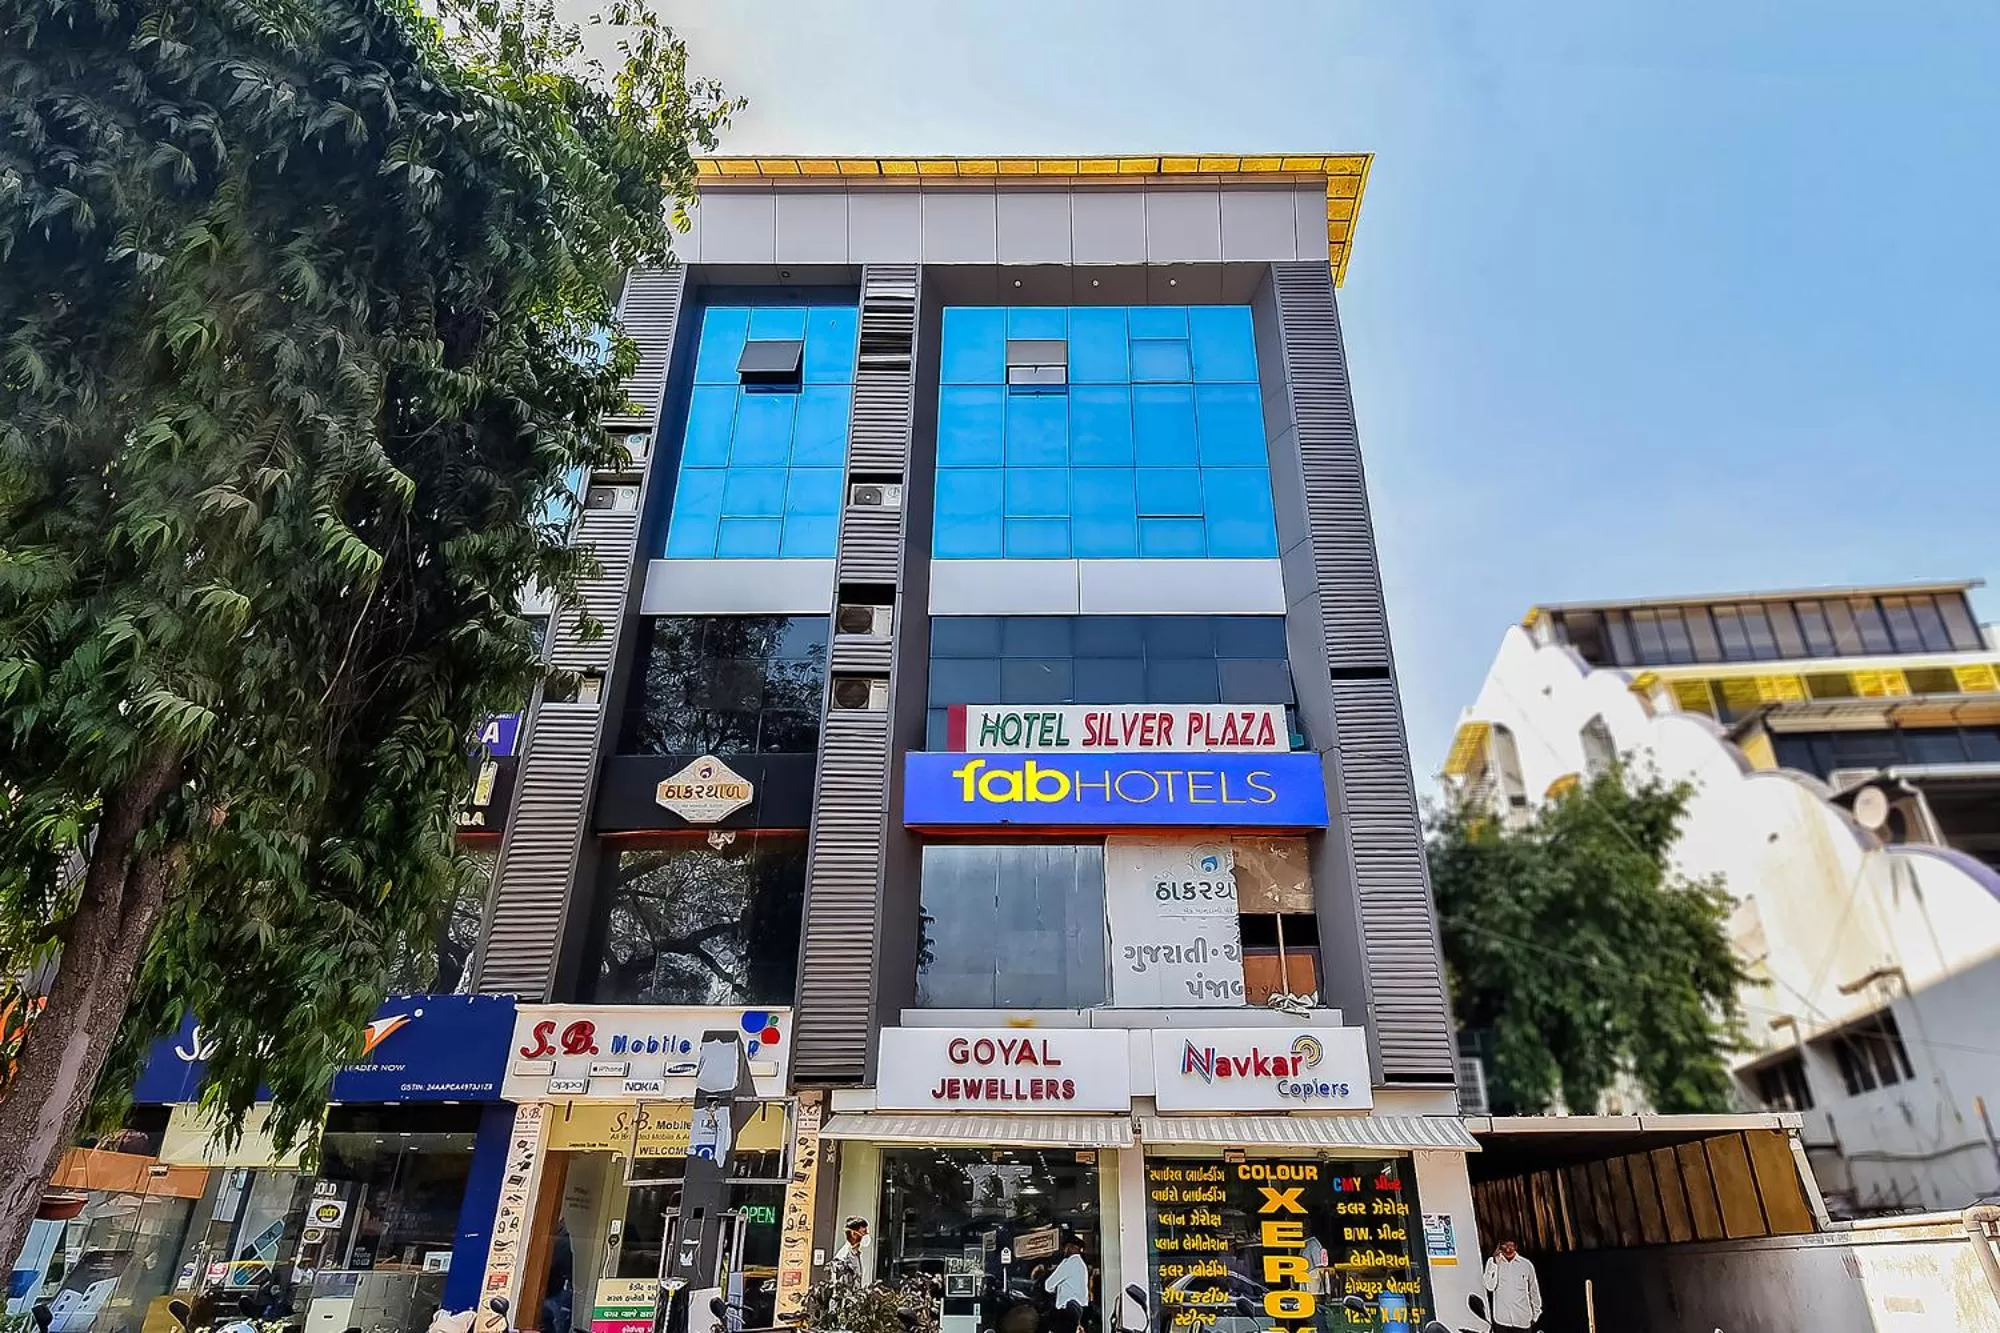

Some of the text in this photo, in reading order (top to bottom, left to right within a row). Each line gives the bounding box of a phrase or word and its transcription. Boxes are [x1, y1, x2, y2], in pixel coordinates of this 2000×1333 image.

[980, 712, 1277, 748] HOTEL SILVER PLAZA
[610, 1034, 694, 1055] Mobile
[948, 1038, 1062, 1067] GOYAL
[380, 1064, 407, 1072] NOW
[1181, 1038, 1304, 1086] Navkar
[624, 1082, 660, 1092] NOKIA
[931, 1077, 1076, 1101] JEWELLERS
[1277, 1079, 1350, 1102] Copiers
[1238, 1164, 1319, 1181] COLOUR
[738, 1205, 776, 1224] OPEN
